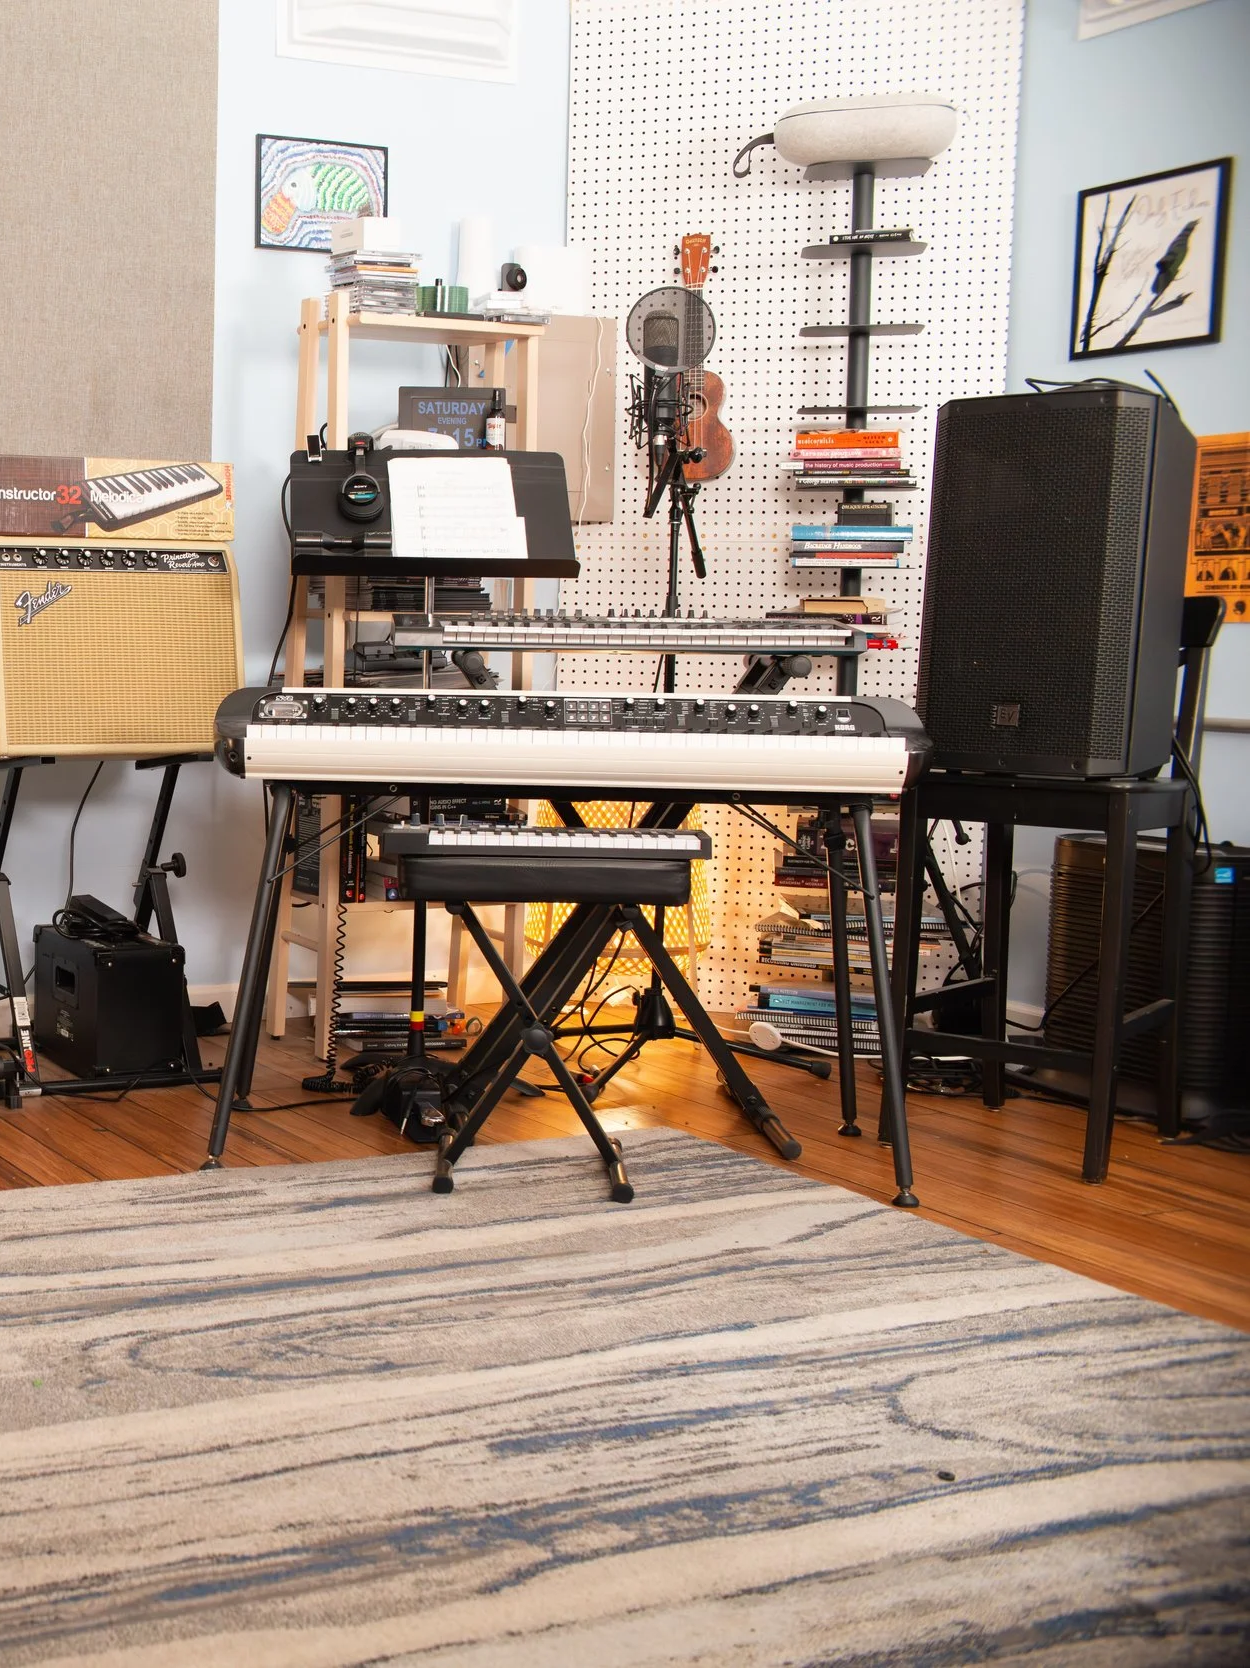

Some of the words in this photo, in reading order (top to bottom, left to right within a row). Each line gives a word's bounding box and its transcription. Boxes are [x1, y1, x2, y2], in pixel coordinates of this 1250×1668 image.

[417, 400, 486, 415] SATURDAY
[437, 416, 467, 425] EVENING
[224, 465, 232, 501] HOHNER
[90, 489, 145, 505] Melodica
[161, 552, 199, 562] Princeton
[14, 580, 72, 625] Fender
[21, 1029, 36, 1073] PROLINE
